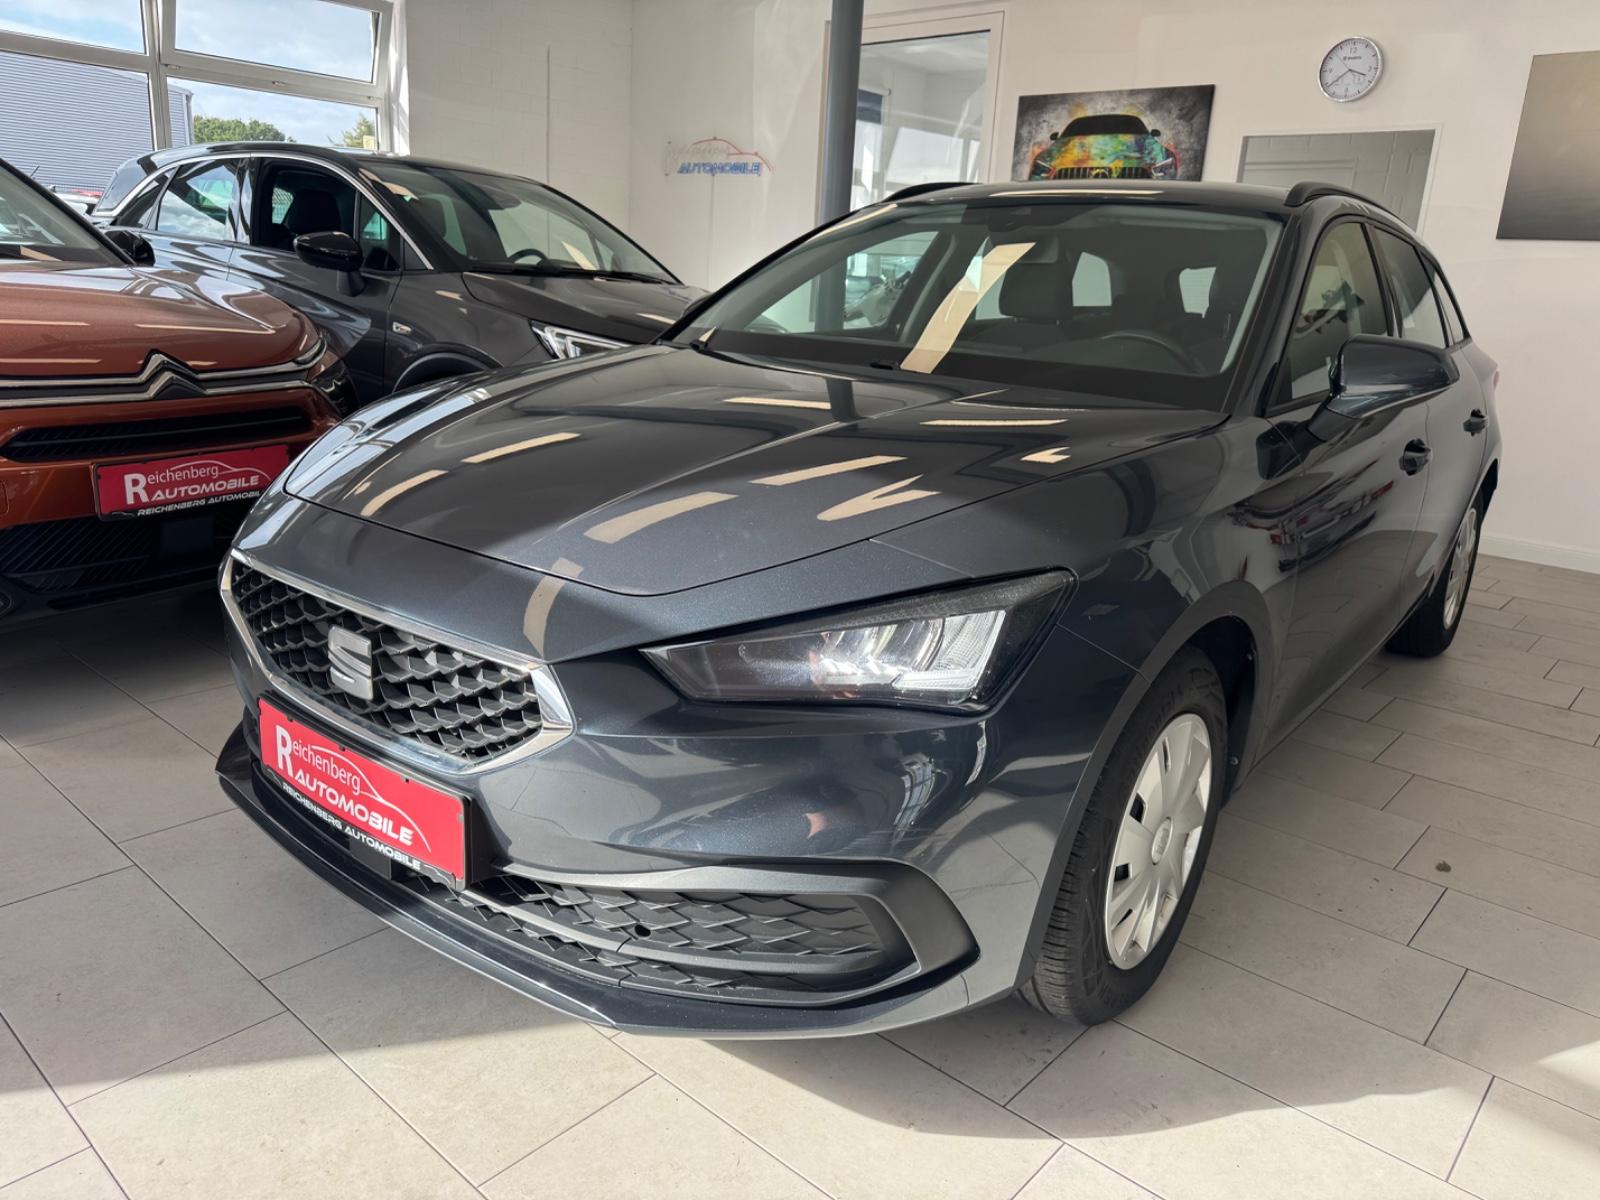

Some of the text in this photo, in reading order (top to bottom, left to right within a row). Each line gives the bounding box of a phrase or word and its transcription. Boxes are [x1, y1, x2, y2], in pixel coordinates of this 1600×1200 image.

[124, 463, 220, 505] Reichenberg
[137, 491, 261, 517] REICHENBERG AUTOMOBIL
[151, 475, 260, 502] AUTOMOBILE
[275, 724, 362, 796] Reichenberg
[282, 782, 422, 871] REICHENBERG AUTOMOBILE
[294, 768, 415, 847] AUTOMOBILE
